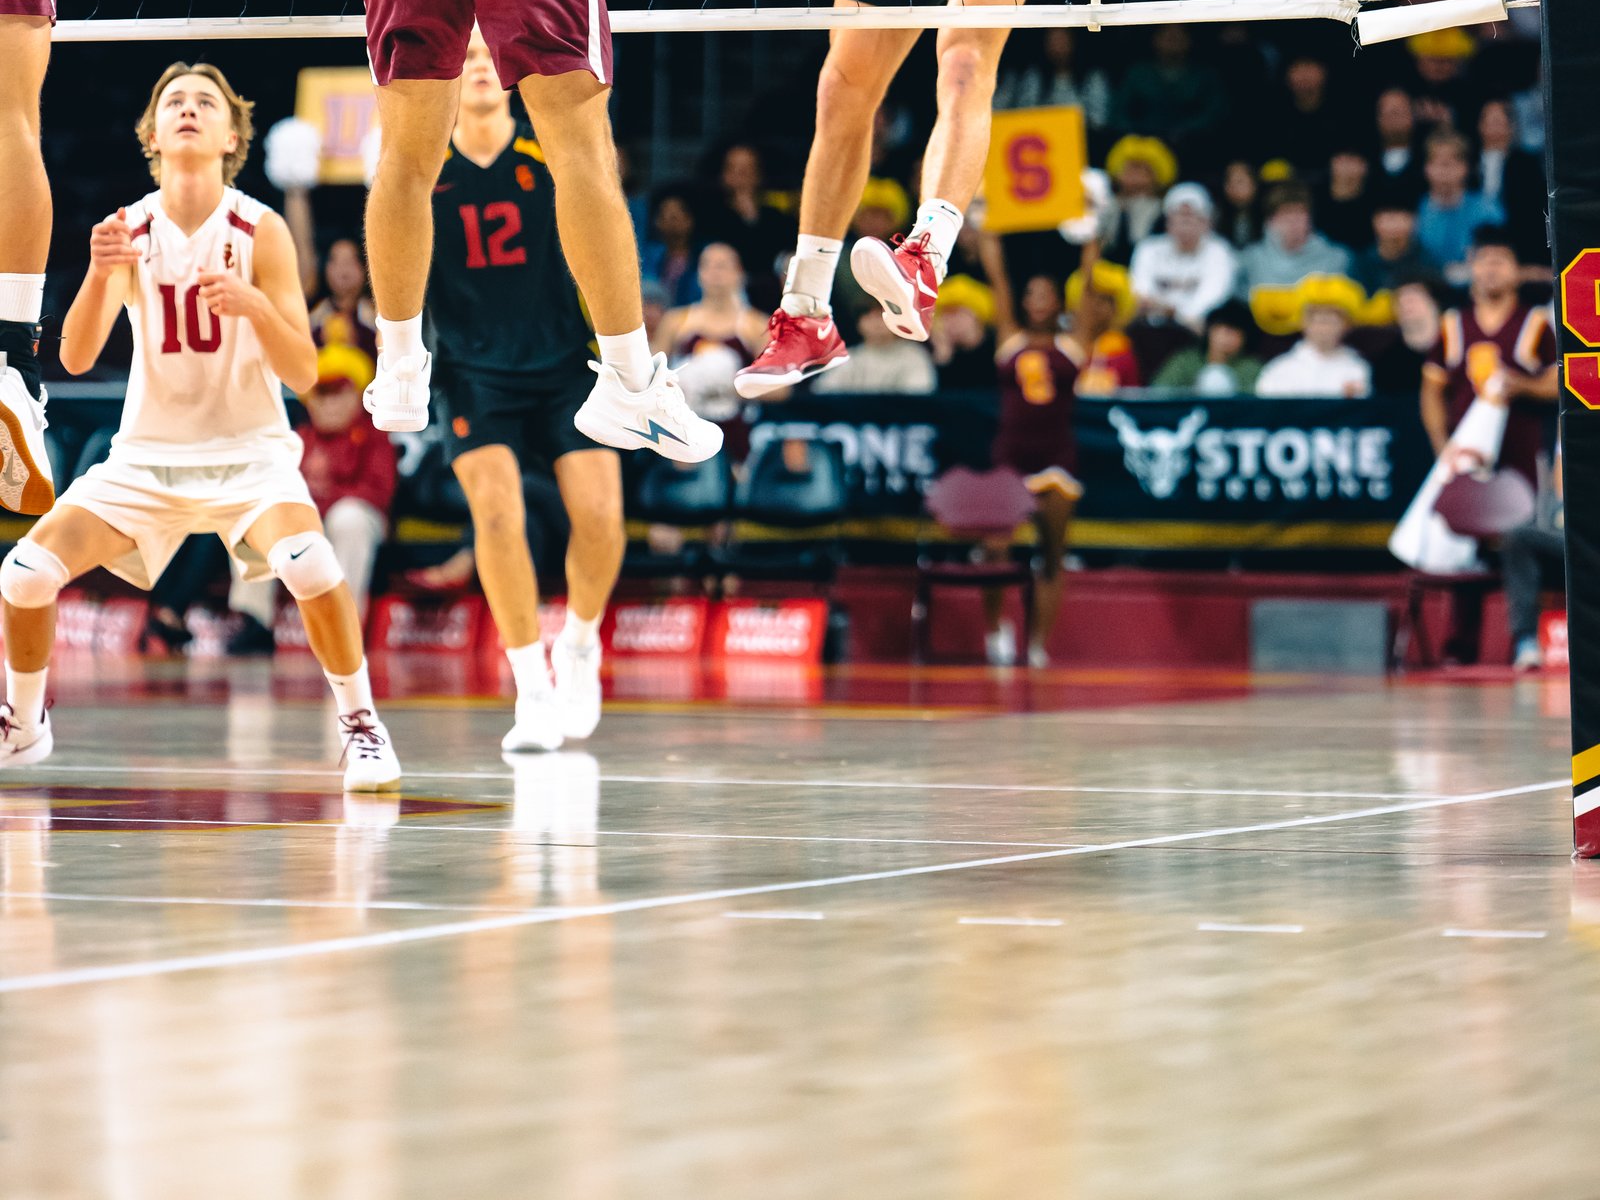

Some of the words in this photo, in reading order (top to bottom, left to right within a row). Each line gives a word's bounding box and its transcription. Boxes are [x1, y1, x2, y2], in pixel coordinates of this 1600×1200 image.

[1006, 135, 1052, 199] S
[459, 201, 527, 268] 12
[159, 284, 221, 354] 10
[1196, 427, 1392, 479] STONE
